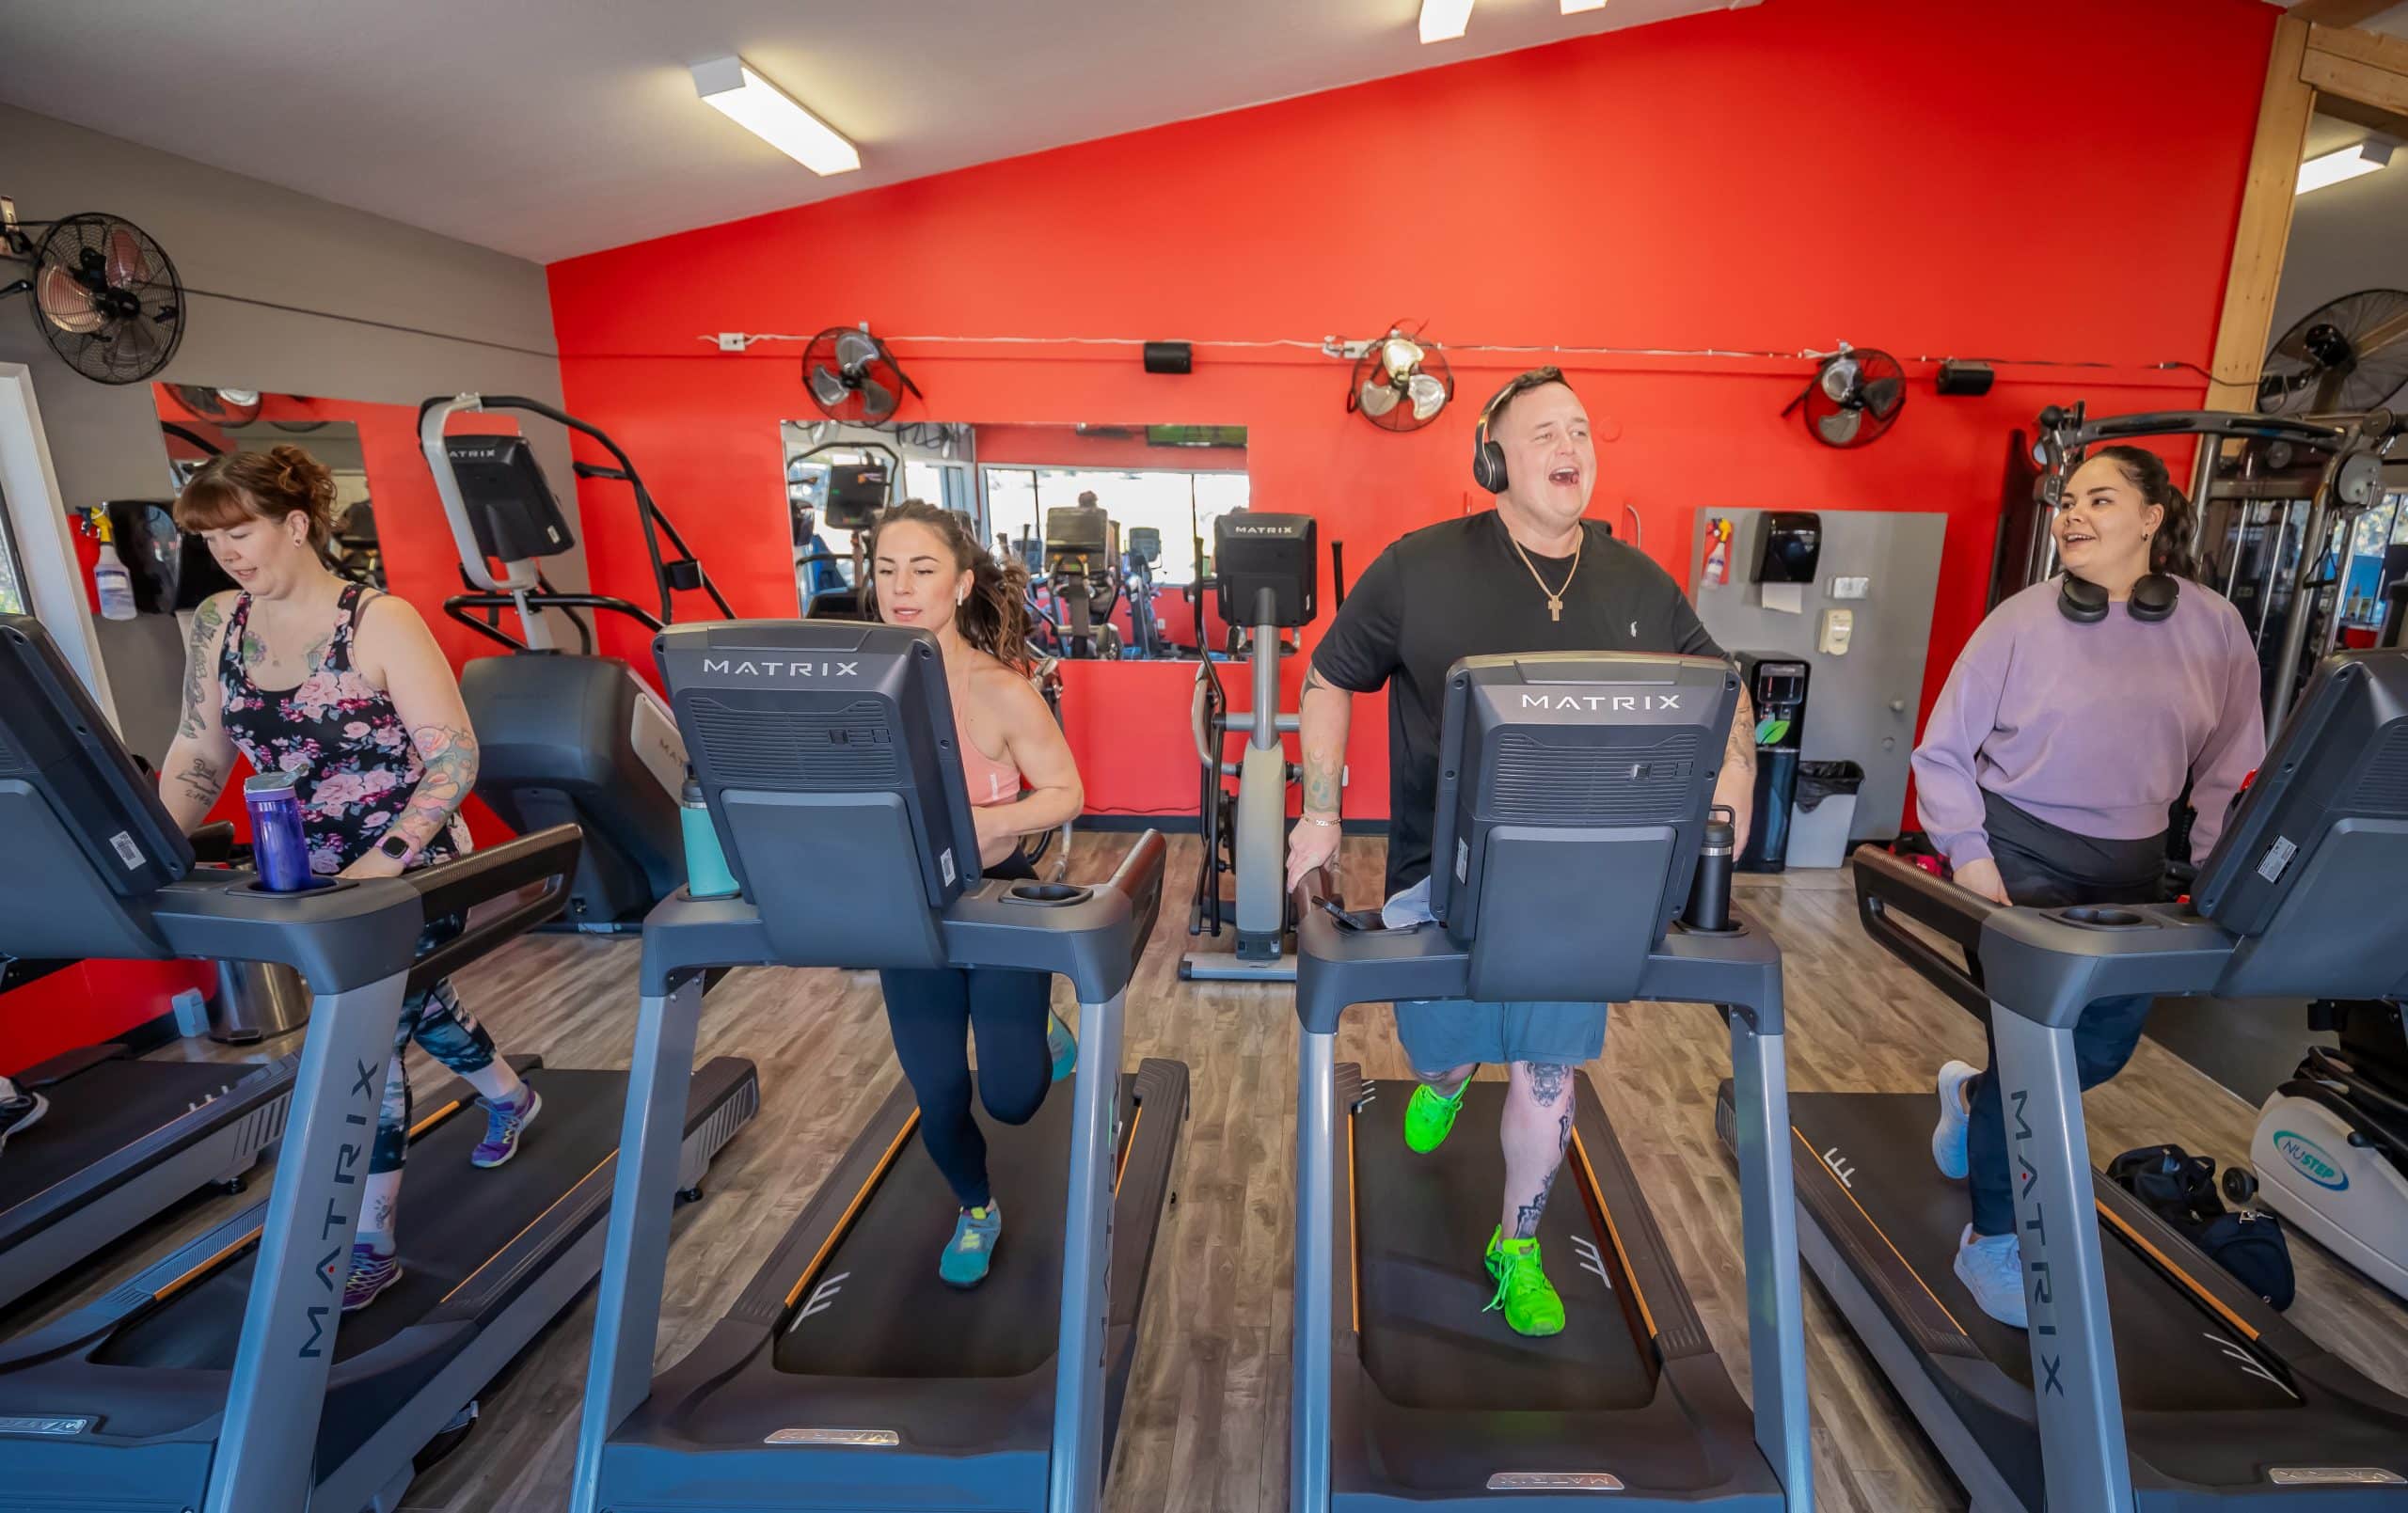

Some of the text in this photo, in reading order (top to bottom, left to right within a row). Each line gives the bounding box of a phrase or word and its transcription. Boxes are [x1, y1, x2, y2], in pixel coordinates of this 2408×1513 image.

[449, 449, 496, 458] ATRIX
[704, 658, 859, 677] MATRIX
[1521, 694, 1681, 711] MATRIX
[2282, 1138, 2335, 1178] NUSTEP
[298, 1058, 378, 1359] MATRIX
[2010, 1090, 2065, 1397] MATRIX
